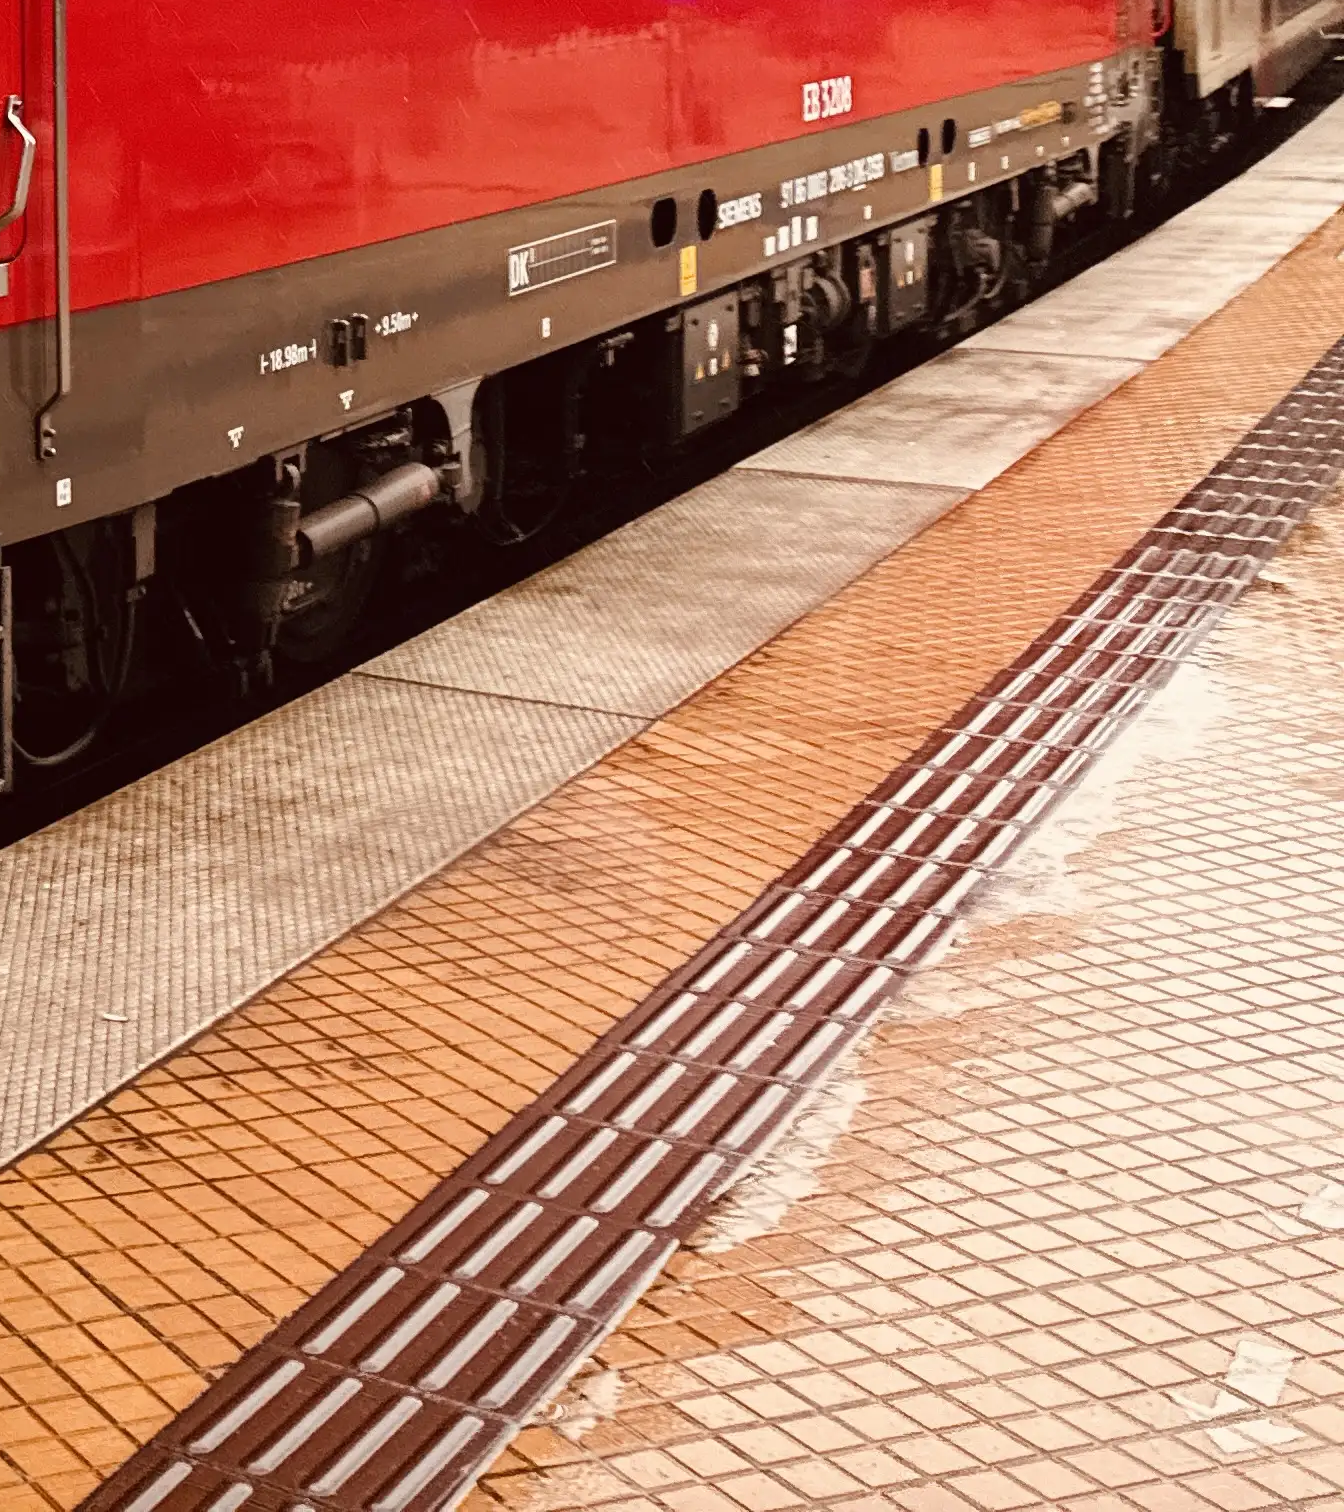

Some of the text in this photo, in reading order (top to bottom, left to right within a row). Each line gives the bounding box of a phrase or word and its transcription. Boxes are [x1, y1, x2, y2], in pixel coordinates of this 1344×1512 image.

[801, 76, 852, 121] EB 3208
[511, 251, 529, 288] DK
[270, 344, 308, 371] 18.98m
